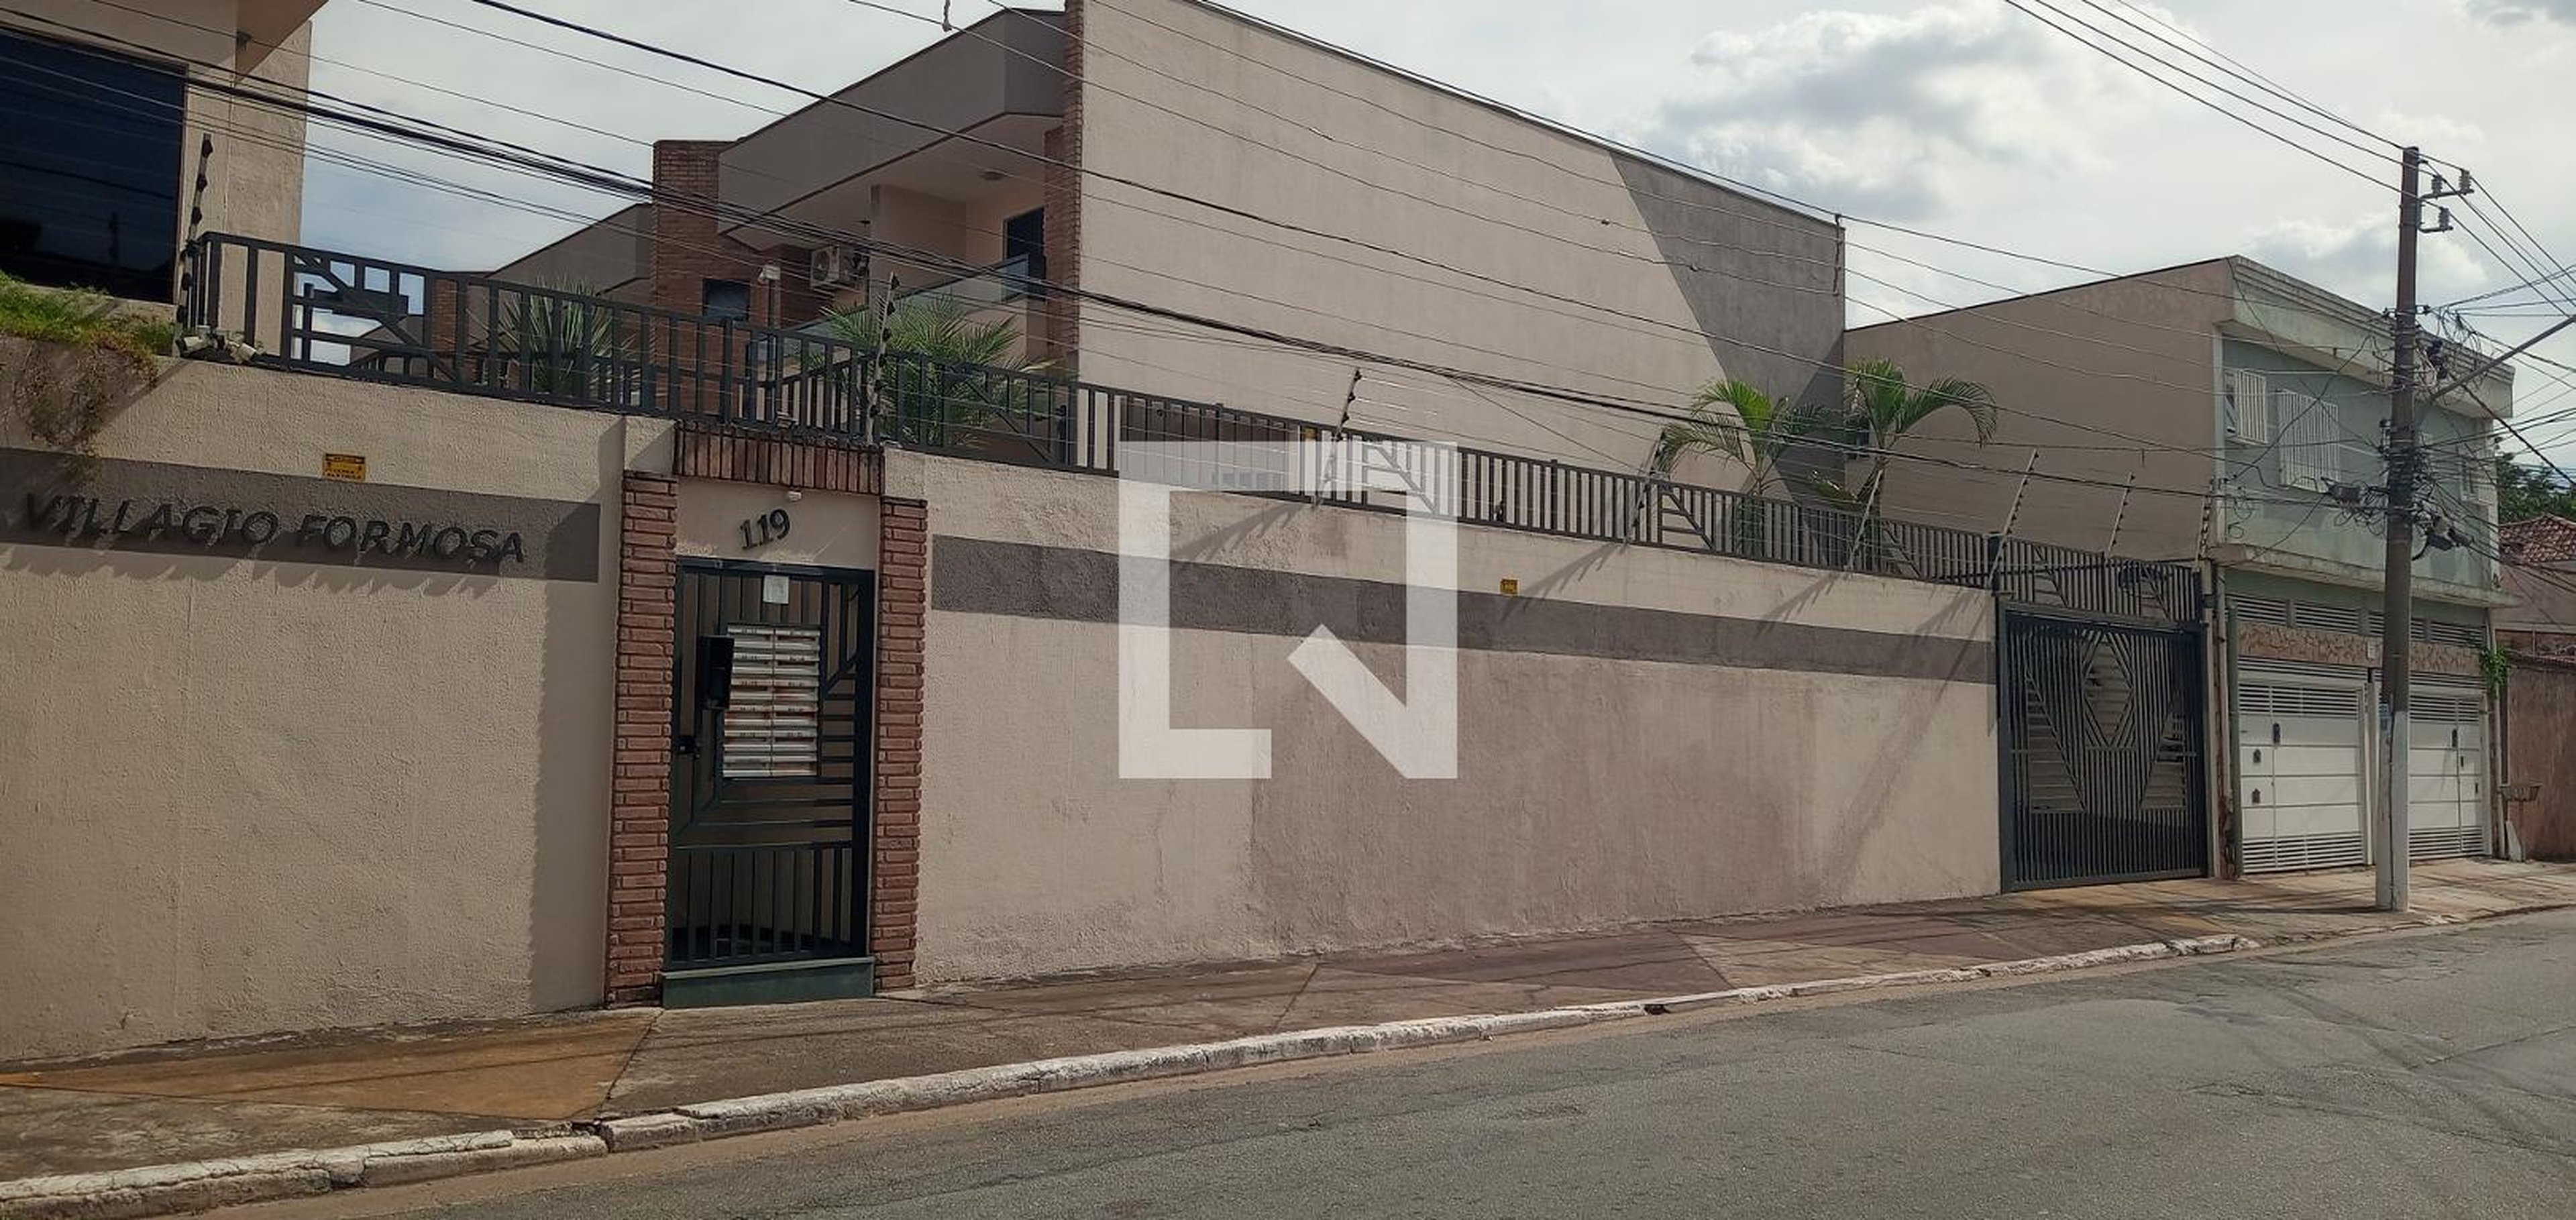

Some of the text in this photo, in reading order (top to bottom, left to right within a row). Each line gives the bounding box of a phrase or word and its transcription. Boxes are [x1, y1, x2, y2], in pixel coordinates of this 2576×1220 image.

[25, 492, 523, 563] VILLAGIO FORMOSA
[739, 508, 790, 550] 119
